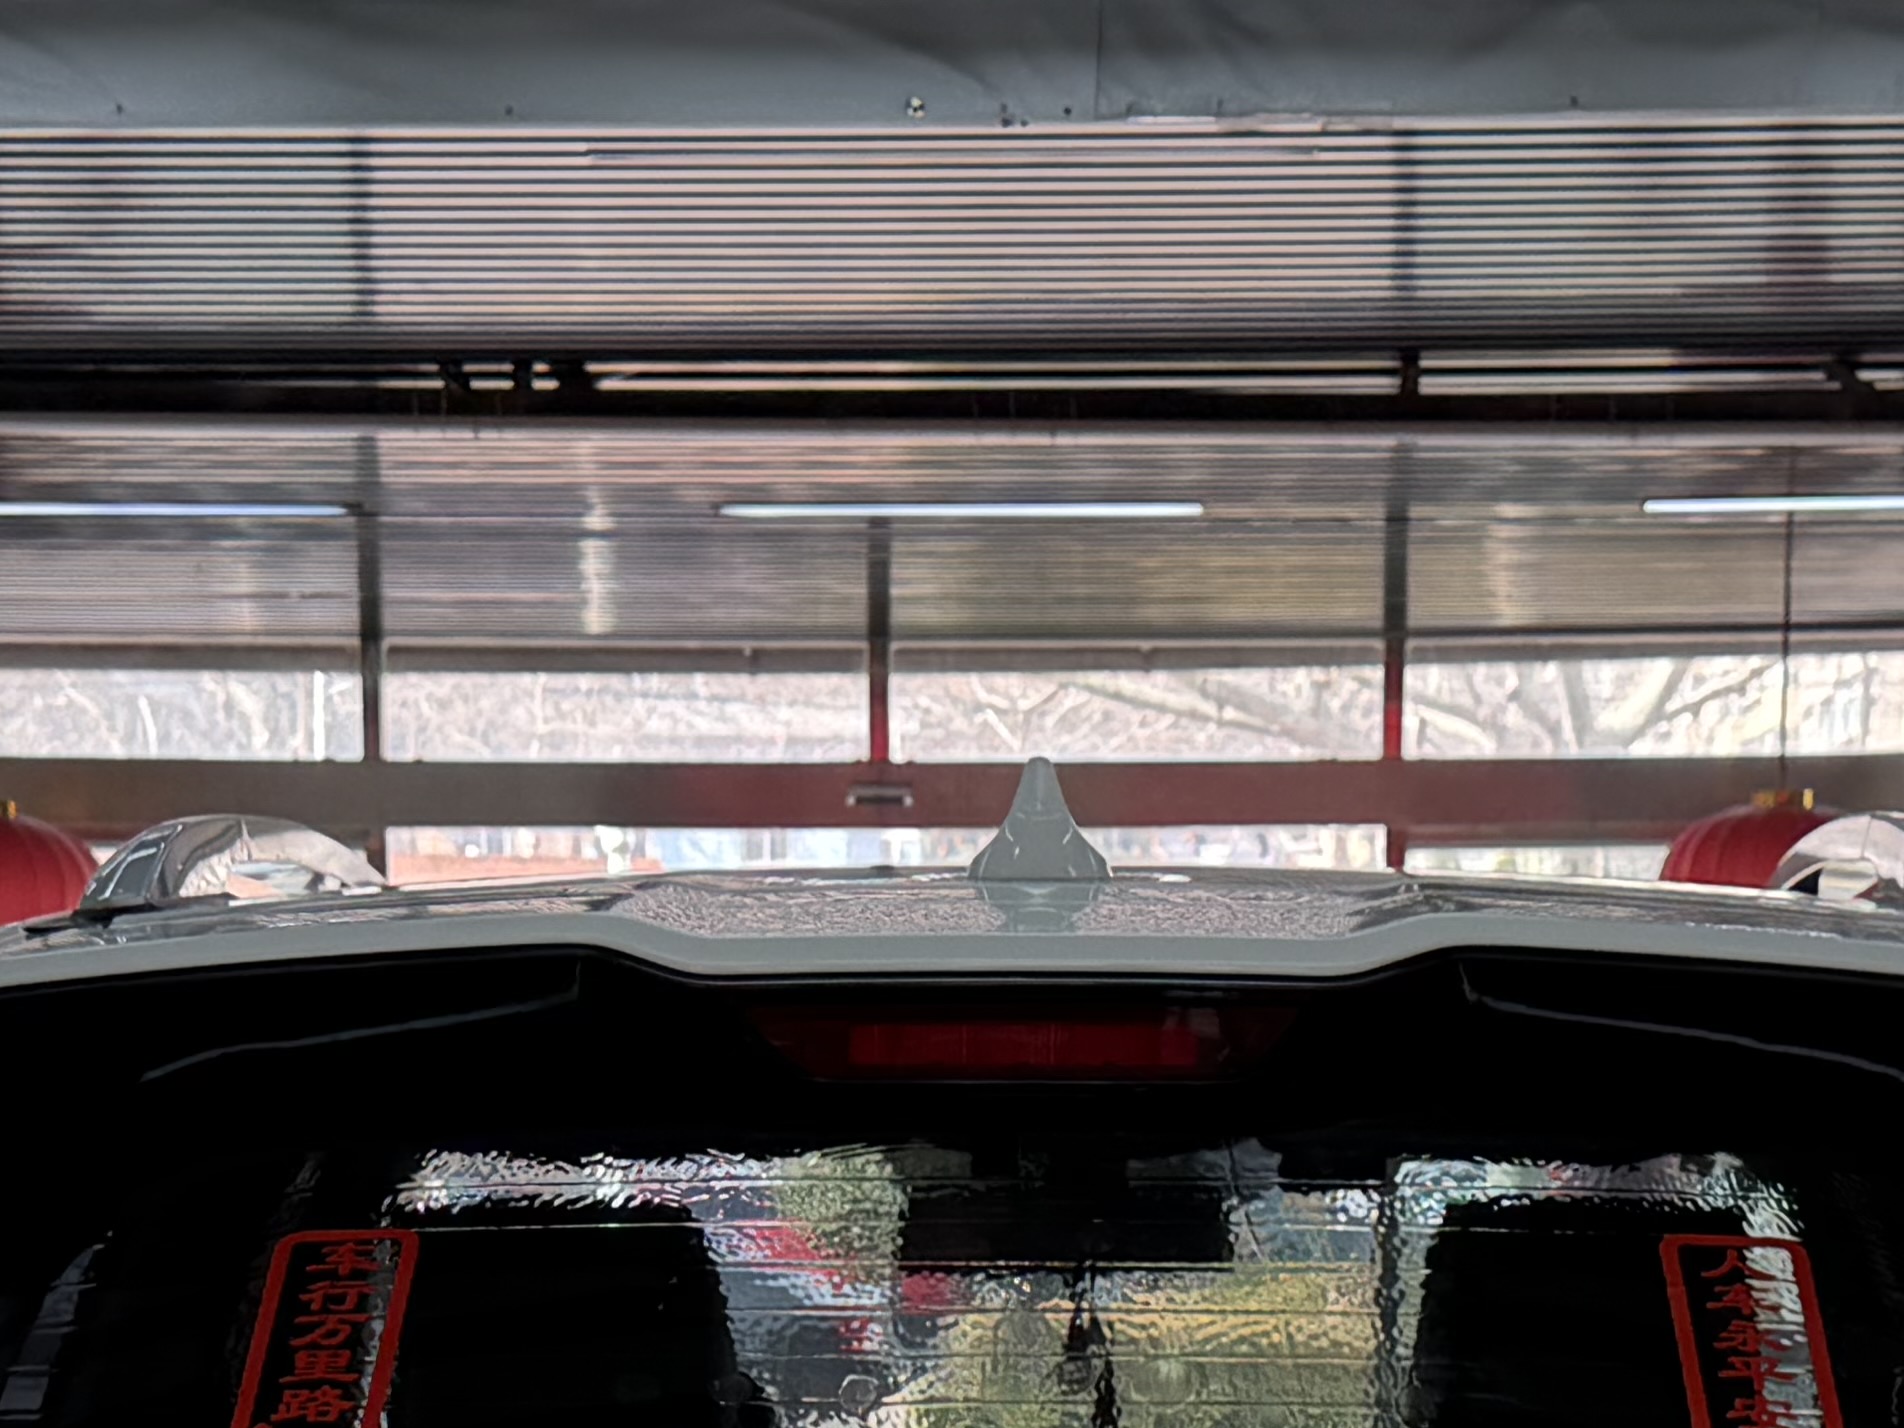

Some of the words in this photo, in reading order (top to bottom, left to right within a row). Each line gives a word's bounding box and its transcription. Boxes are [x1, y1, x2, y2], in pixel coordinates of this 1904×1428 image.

[270, 1242, 384, 1423] 车行万里路
